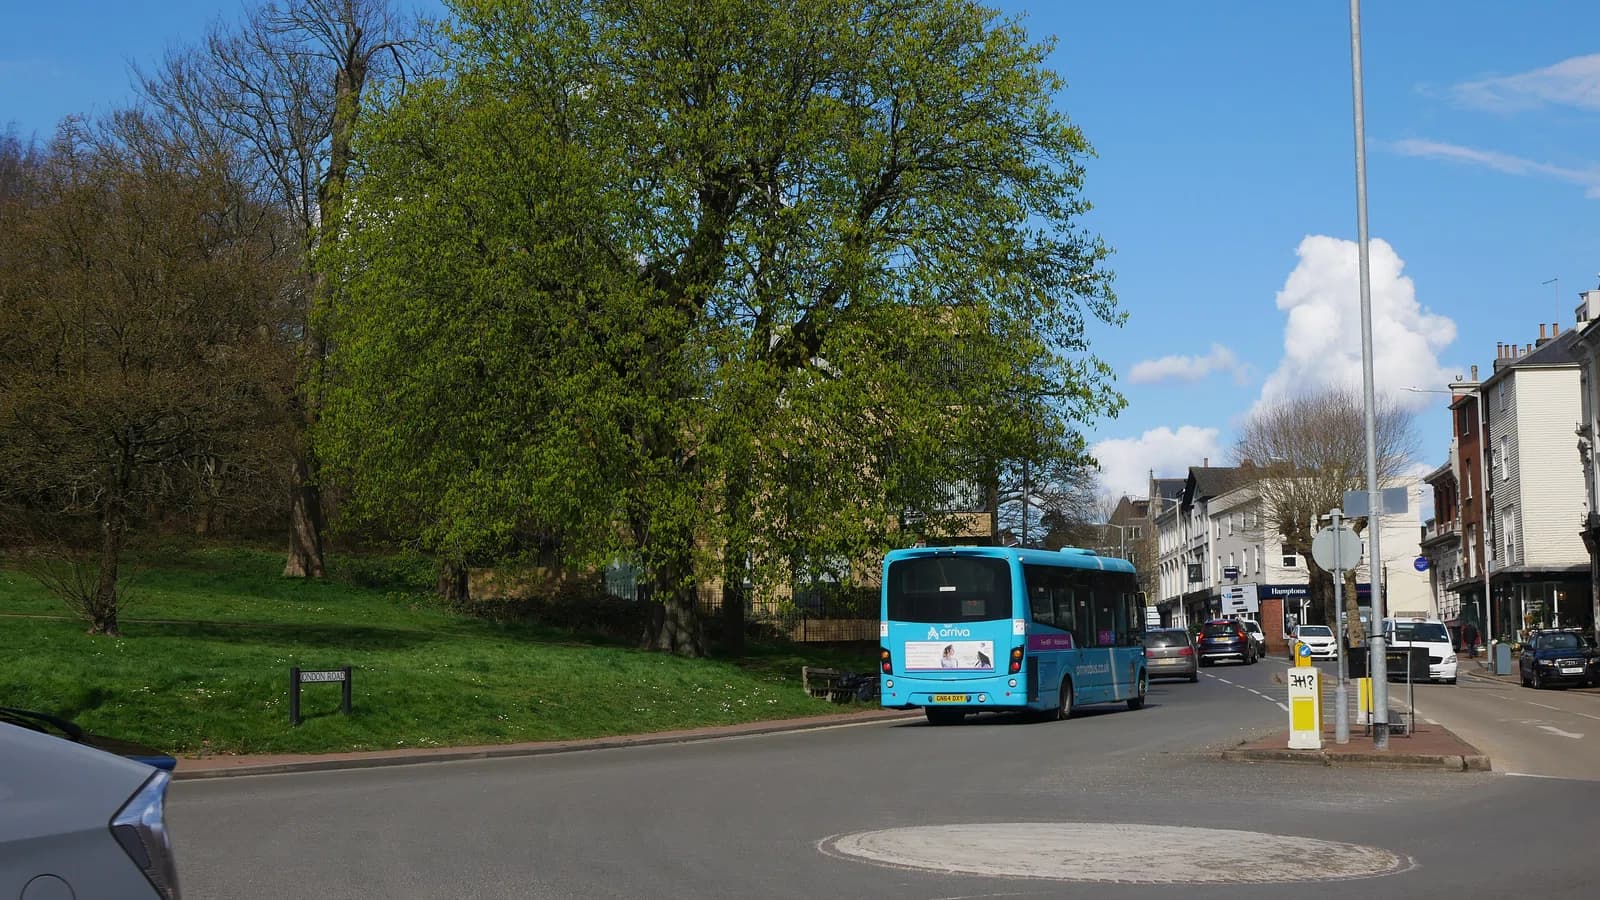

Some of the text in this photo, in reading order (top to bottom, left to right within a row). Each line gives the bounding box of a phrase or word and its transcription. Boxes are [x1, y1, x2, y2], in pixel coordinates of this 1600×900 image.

[1271, 587, 1306, 596] Hamptons
[940, 627, 970, 637] arriva
[327, 671, 345, 681] ROAD
